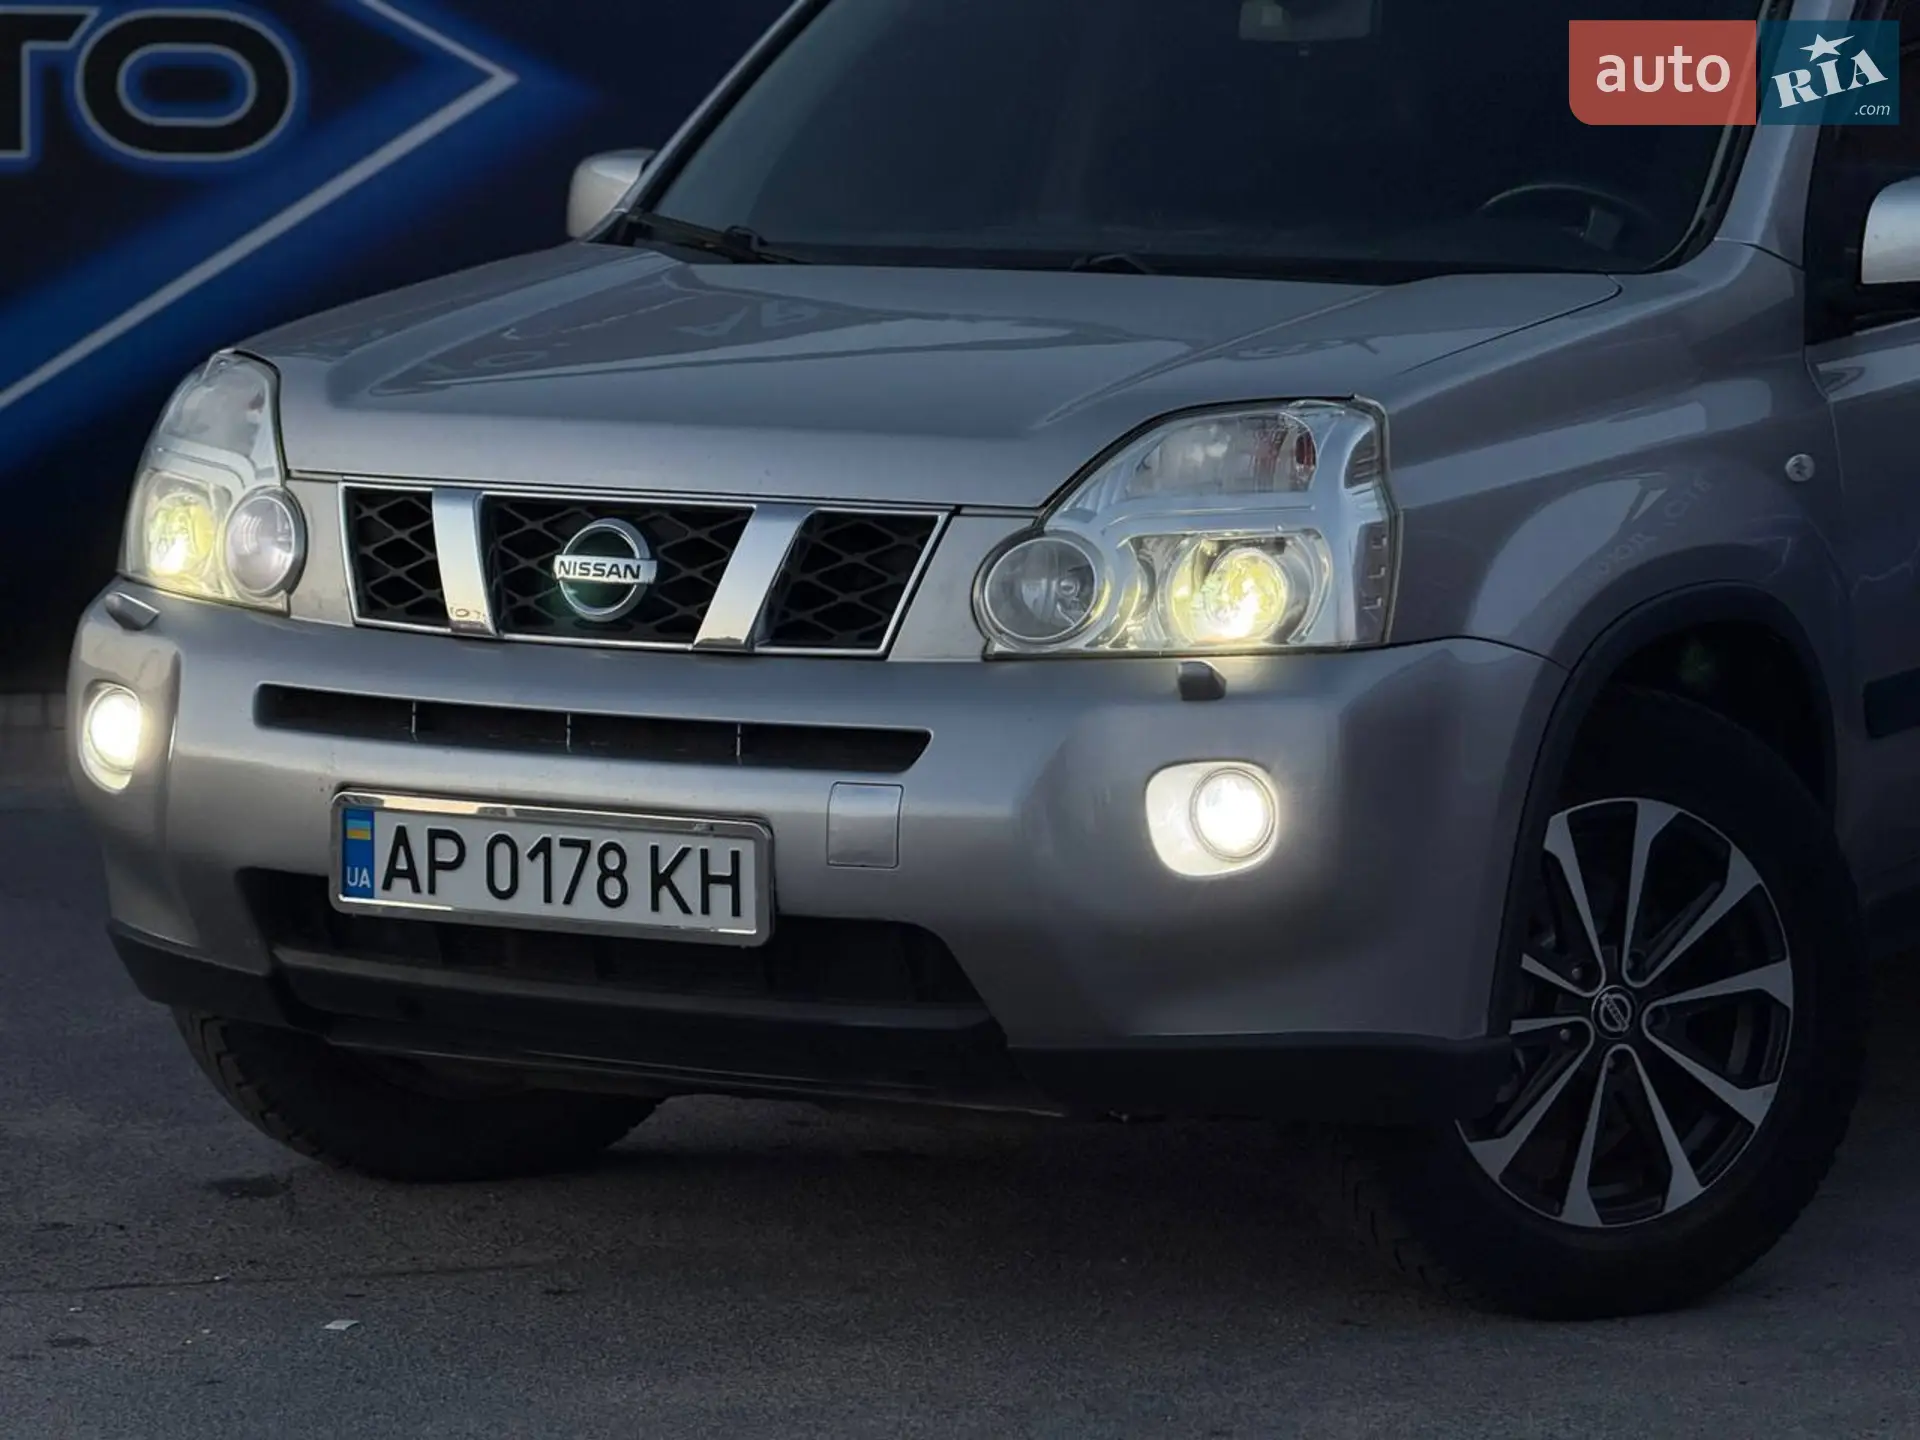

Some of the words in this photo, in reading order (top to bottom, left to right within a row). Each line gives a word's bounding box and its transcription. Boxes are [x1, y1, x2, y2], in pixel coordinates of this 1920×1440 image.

[557, 560, 641, 580] NISSAN
[347, 866, 371, 889] UA
[381, 824, 467, 896] AP
[485, 832, 629, 910] 0178
[649, 843, 742, 918] KH
